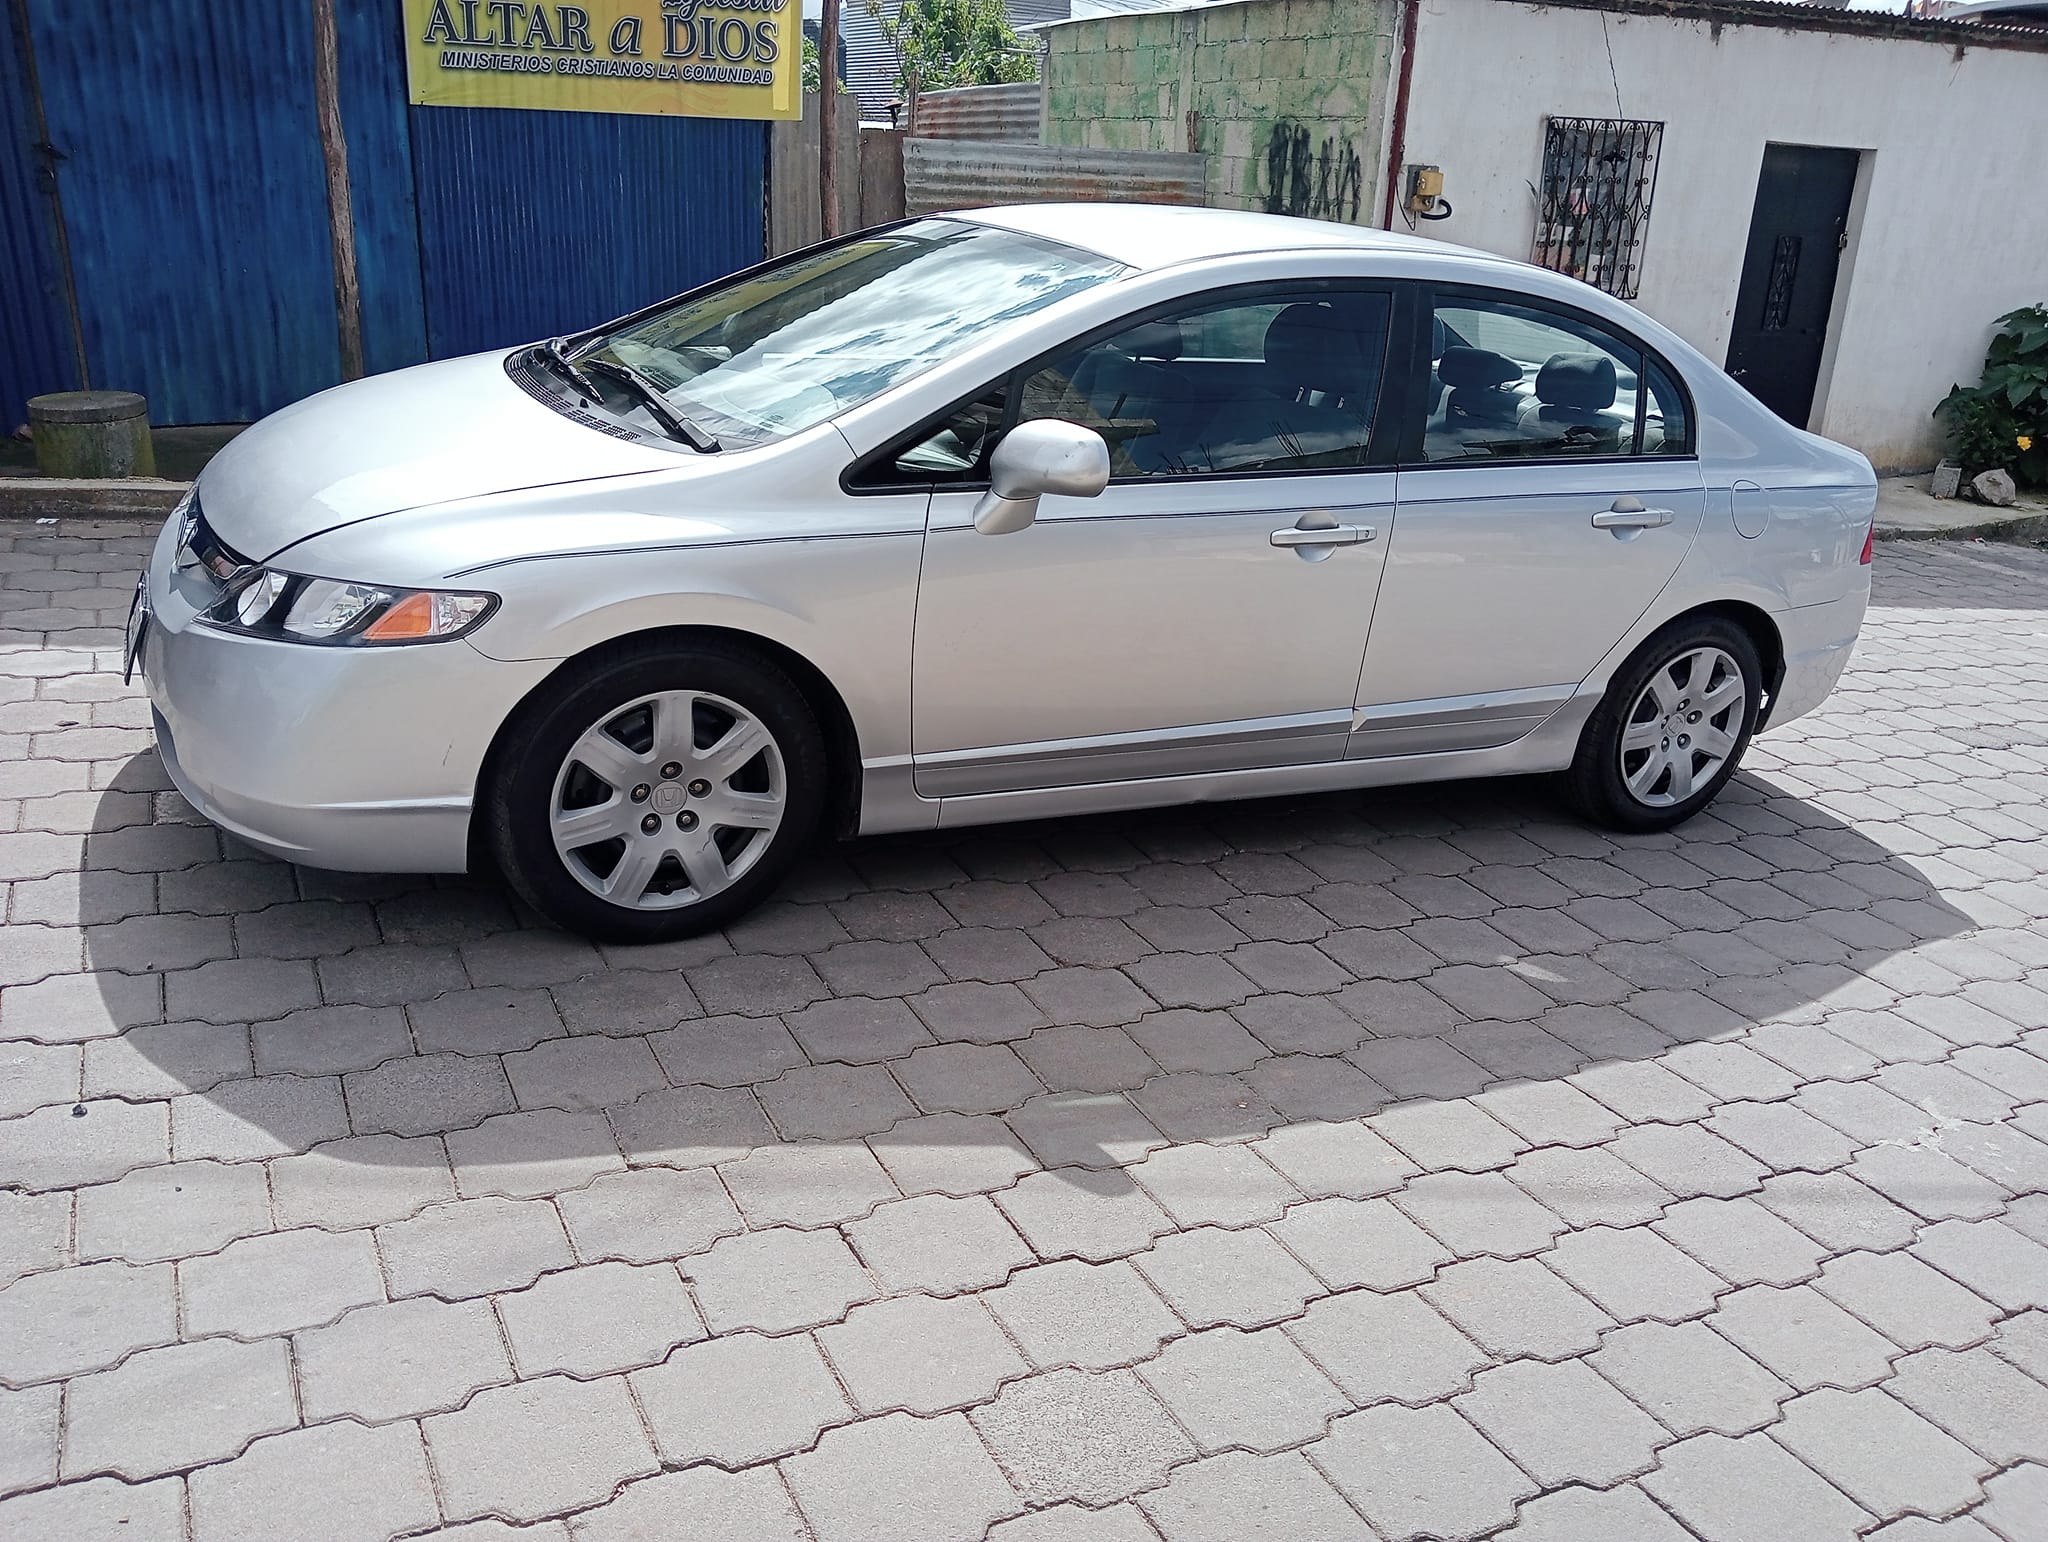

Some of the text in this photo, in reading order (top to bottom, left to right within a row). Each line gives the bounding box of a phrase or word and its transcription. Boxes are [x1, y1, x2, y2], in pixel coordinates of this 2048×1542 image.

[422, 0, 780, 63] ALTAR a DIOS
[440, 51, 775, 86] MINISTERIOS CRISTIANOS LA COMUNIDAD
